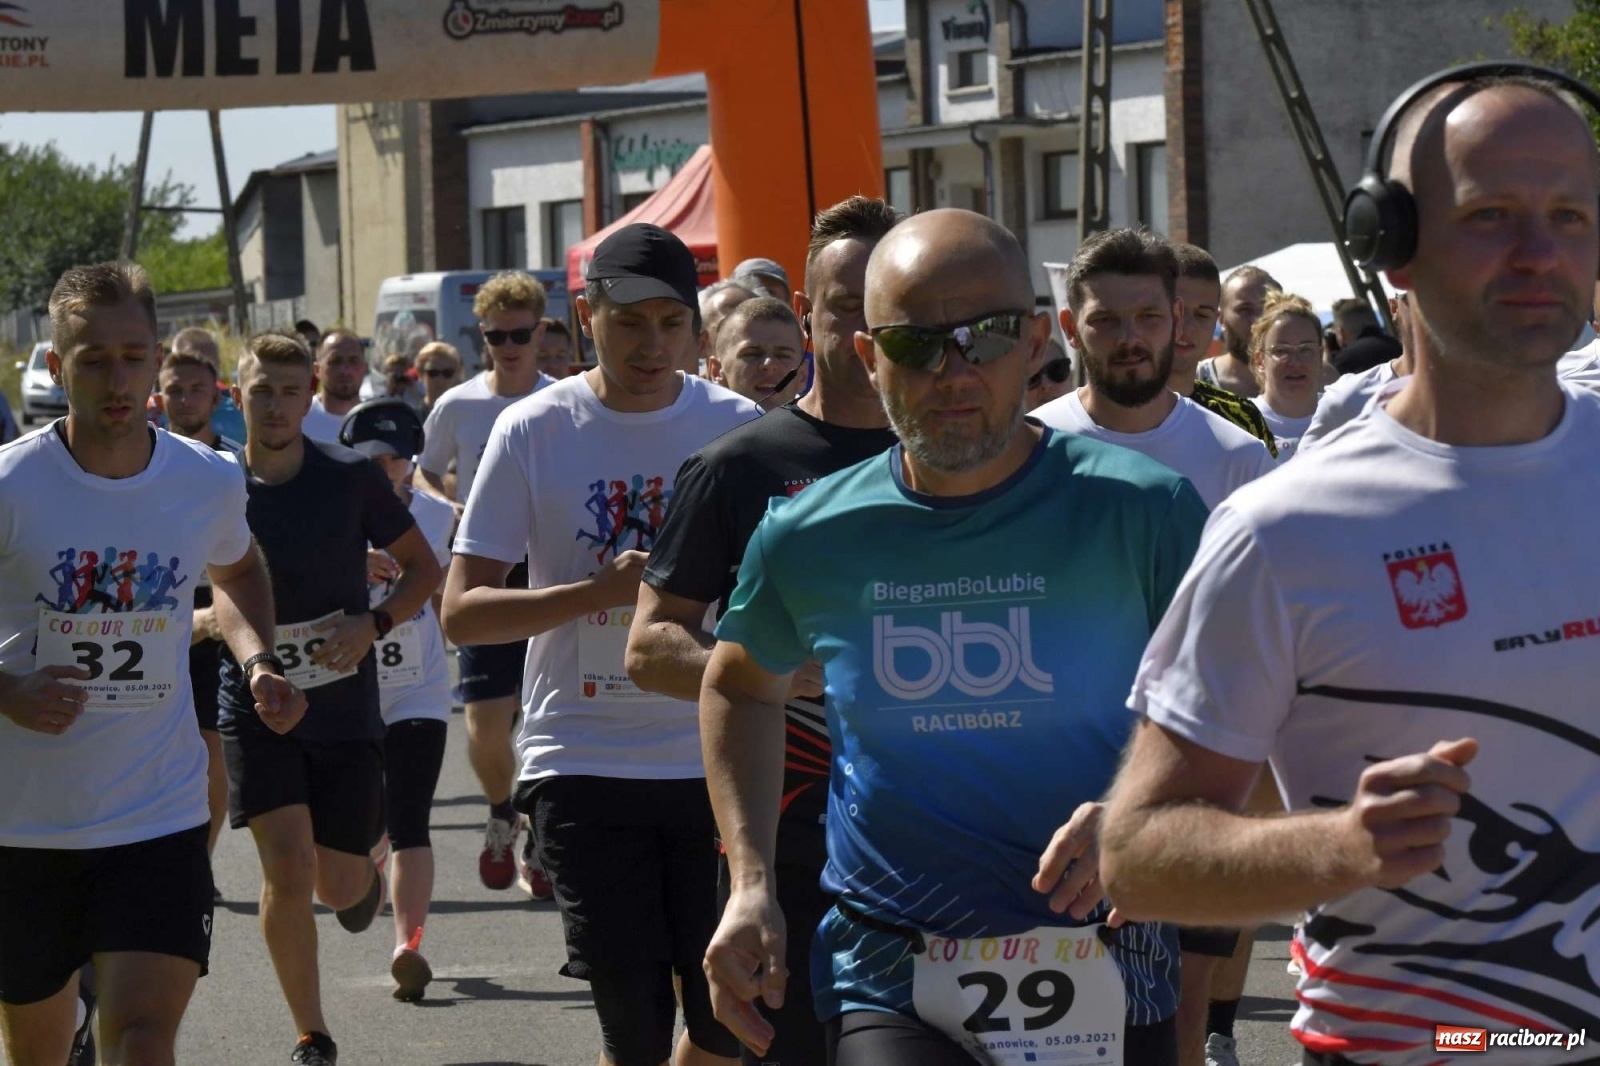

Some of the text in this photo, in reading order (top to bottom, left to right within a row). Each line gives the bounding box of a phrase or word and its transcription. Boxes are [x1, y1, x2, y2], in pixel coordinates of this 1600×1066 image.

[873, 573, 1047, 602] BiegamBoLubię
[49, 617, 167, 638] COLOUR RUN
[71, 640, 144, 681] 32
[872, 606, 1054, 701] bbl
[125, 684, 172, 692] 05.09.2021
[911, 709, 1023, 733] RACIBÓRZ
[927, 937, 1040, 964] COLOUR
[957, 969, 1075, 1033] 29
[1045, 1033, 1116, 1047] 05.09.2021
